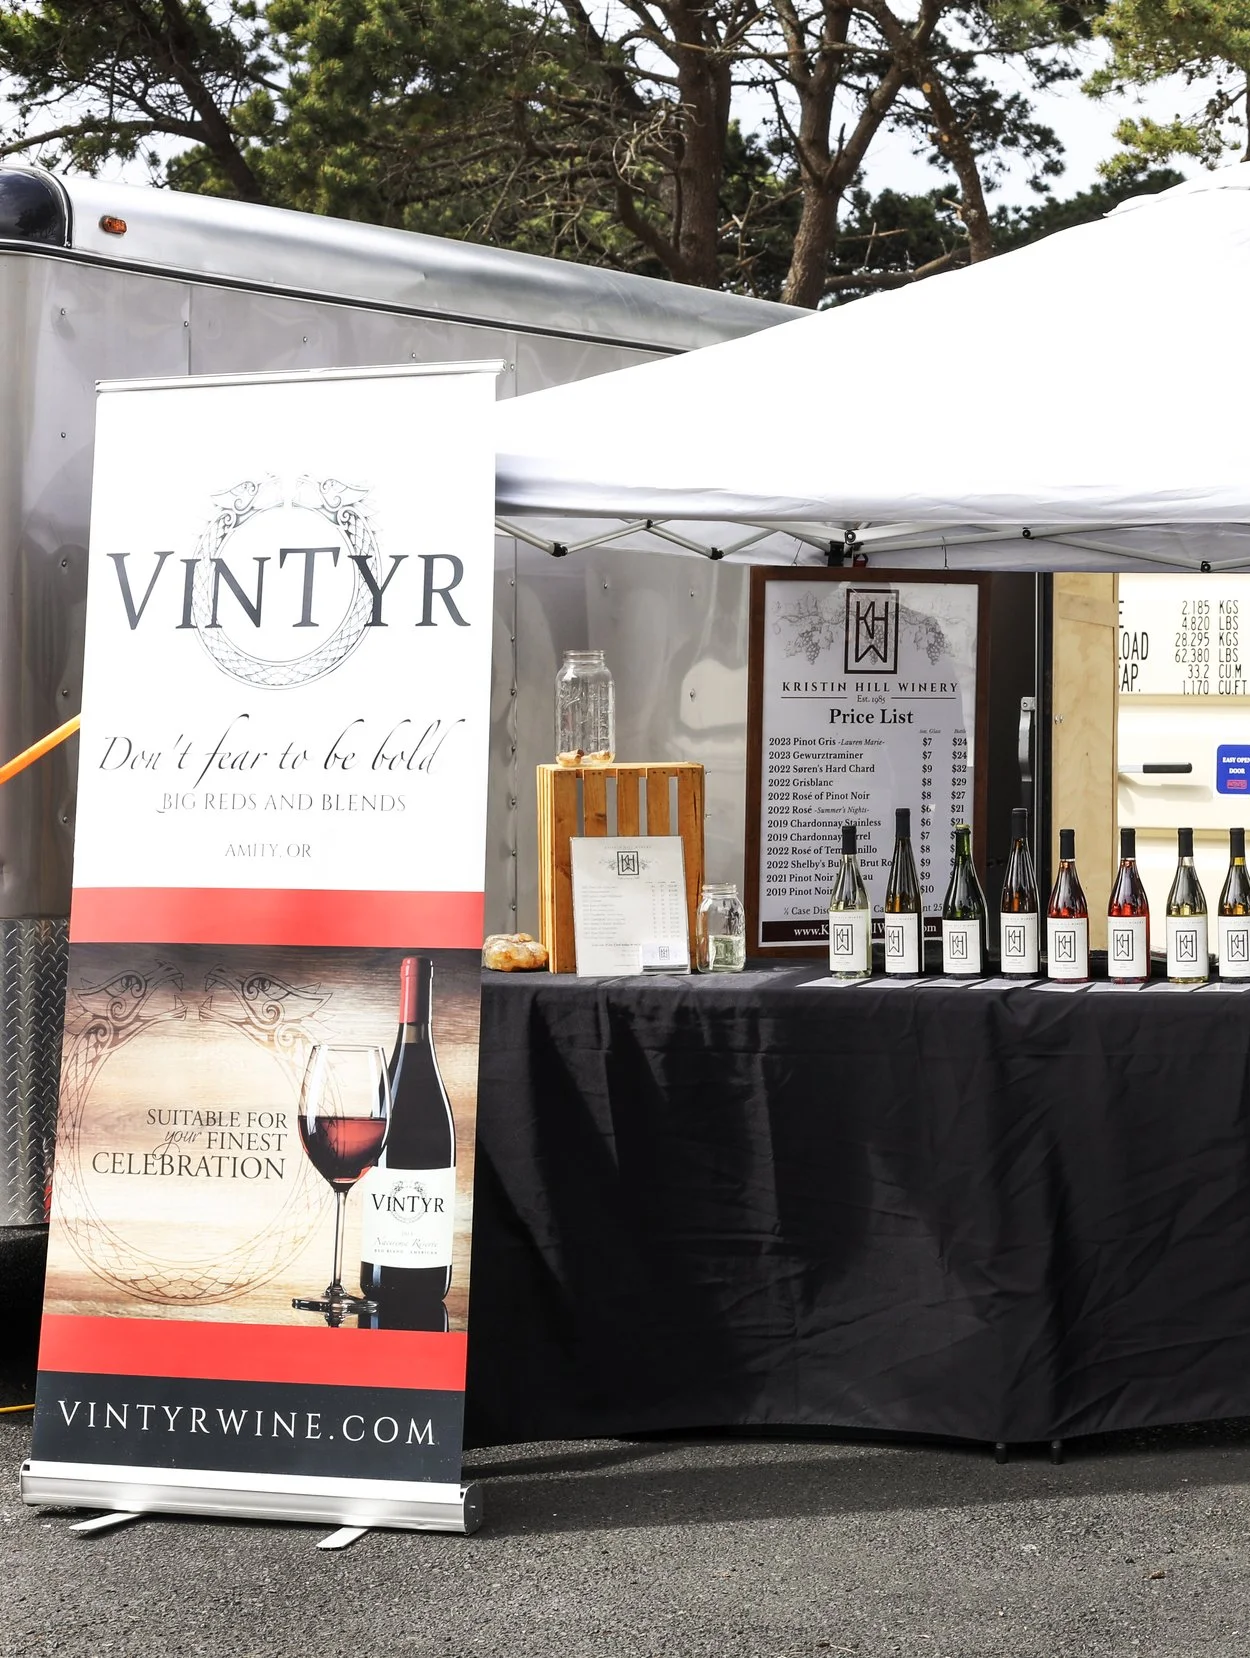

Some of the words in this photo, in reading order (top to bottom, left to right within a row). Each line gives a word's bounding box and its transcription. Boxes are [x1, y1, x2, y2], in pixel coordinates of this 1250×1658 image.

[106, 547, 471, 630] VINTYR
[1219, 600, 1239, 614] KGS
[1219, 616, 1239, 630] LBS
[1119, 632, 1149, 660] OAD
[1219, 632, 1239, 646] KGS
[1219, 648, 1239, 662] LBS
[1119, 664, 1141, 692] AP.
[1187, 665, 1209, 679] 33.2
[782, 681, 847, 692] KRISTIN
[855, 683, 891, 692] HILL
[898, 683, 958, 692] WINERY
[857, 695, 870, 703] Est.
[871, 695, 886, 704] 1985
[829, 708, 874, 724] Price
[880, 709, 913, 724] List
[769, 737, 791, 746] 2023
[793, 737, 816, 746] Pinot
[818, 737, 836, 746] Gris
[922, 737, 932, 747] $7
[952, 737, 967, 746] $24
[98, 733, 192, 772] Don't
[192, 713, 268, 790] fear
[278, 740, 308, 771] to
[323, 718, 366, 771] be
[371, 718, 466, 776] bold
[769, 752, 791, 760] 2023
[793, 751, 863, 760] Gewurztraminer
[922, 751, 932, 761] $7
[952, 750, 967, 760] $24
[768, 765, 790, 773] 2022
[826, 764, 847, 773] Hard
[849, 764, 875, 773] Chard
[922, 764, 932, 774] $9
[952, 764, 967, 774] $32
[768, 779, 790, 787] 2022
[792, 778, 833, 787] Grisblanc
[921, 778, 932, 787] $8
[951, 777, 966, 787] $29
[768, 793, 790, 801] 2022
[792, 792, 813, 801] Rosé
[815, 792, 824, 800] of
[826, 792, 848, 800] Pinot
[851, 791, 870, 800] Noir
[921, 791, 931, 801] $8
[951, 791, 966, 800] $27
[157, 792, 197, 814] BIG
[204, 792, 257, 812] REDS
[264, 793, 314, 812] AND
[321, 793, 407, 813] BLENDS
[768, 806, 790, 814] 2022
[792, 806, 812, 814] Rosé
[921, 805, 931, 814] $6
[951, 805, 964, 814] $21
[767, 820, 788, 828] 2019
[790, 819, 842, 829] Chardonnay
[844, 818, 881, 827] Stainless
[921, 818, 931, 827] $6
[767, 833, 788, 842] 2019
[790, 832, 842, 843] Chardonnay
[920, 832, 930, 841] $7
[287, 843, 312, 858] OR
[767, 847, 789, 856] 2022
[791, 846, 812, 855] Rosé
[814, 846, 823, 854] of
[920, 845, 931, 855] $8
[767, 861, 789, 869] 2022
[791, 860, 826, 871] Shelby's
[860, 859, 879, 867] Brut
[920, 858, 931, 868] $9
[766, 875, 787, 883] 2021
[789, 874, 812, 882] Pinot
[814, 873, 833, 882] Noir
[920, 872, 930, 881] $9
[766, 888, 787, 897] 2019
[789, 887, 812, 896] Pinot
[814, 887, 833, 896] Noir
[920, 885, 934, 895] $10
[791, 907, 811, 915] Case
[146, 1107, 243, 1128] SUITABLE
[246, 1110, 288, 1129] FOR
[206, 1130, 288, 1153] FINEST
[91, 1151, 286, 1181] CELEBRATION
[371, 1193, 445, 1213] VINTYR
[56, 1398, 437, 1448] VINTYRWINE.COM
